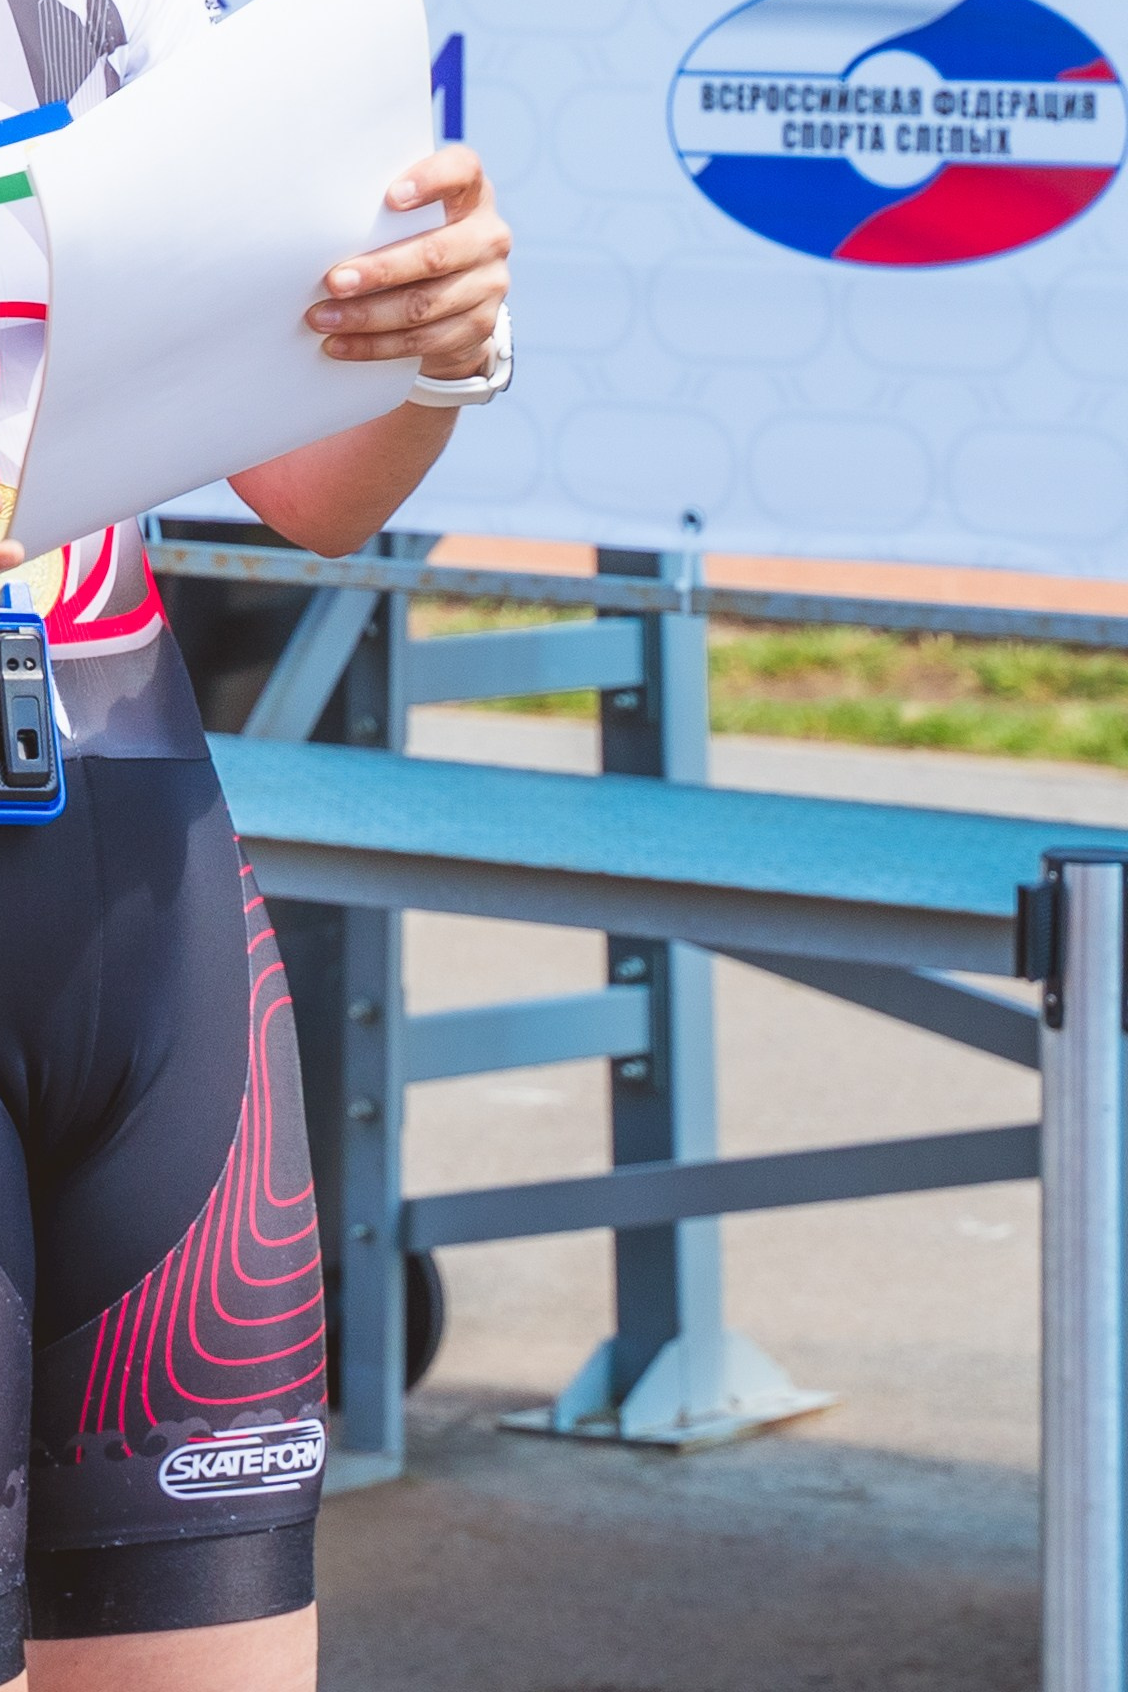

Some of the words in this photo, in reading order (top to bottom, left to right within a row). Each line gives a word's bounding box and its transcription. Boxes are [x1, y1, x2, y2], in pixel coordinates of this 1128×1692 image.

[701, 82, 921, 115] ВСЕРОССИЙСКАЯ
[933, 88, 1097, 122] ФЕДЕРАЦИЯ
[782, 122, 885, 153] СПОРТА
[896, 124, 1012, 156] СЛЕПЫХ
[172, 1440, 321, 1480] SKATEFORM
